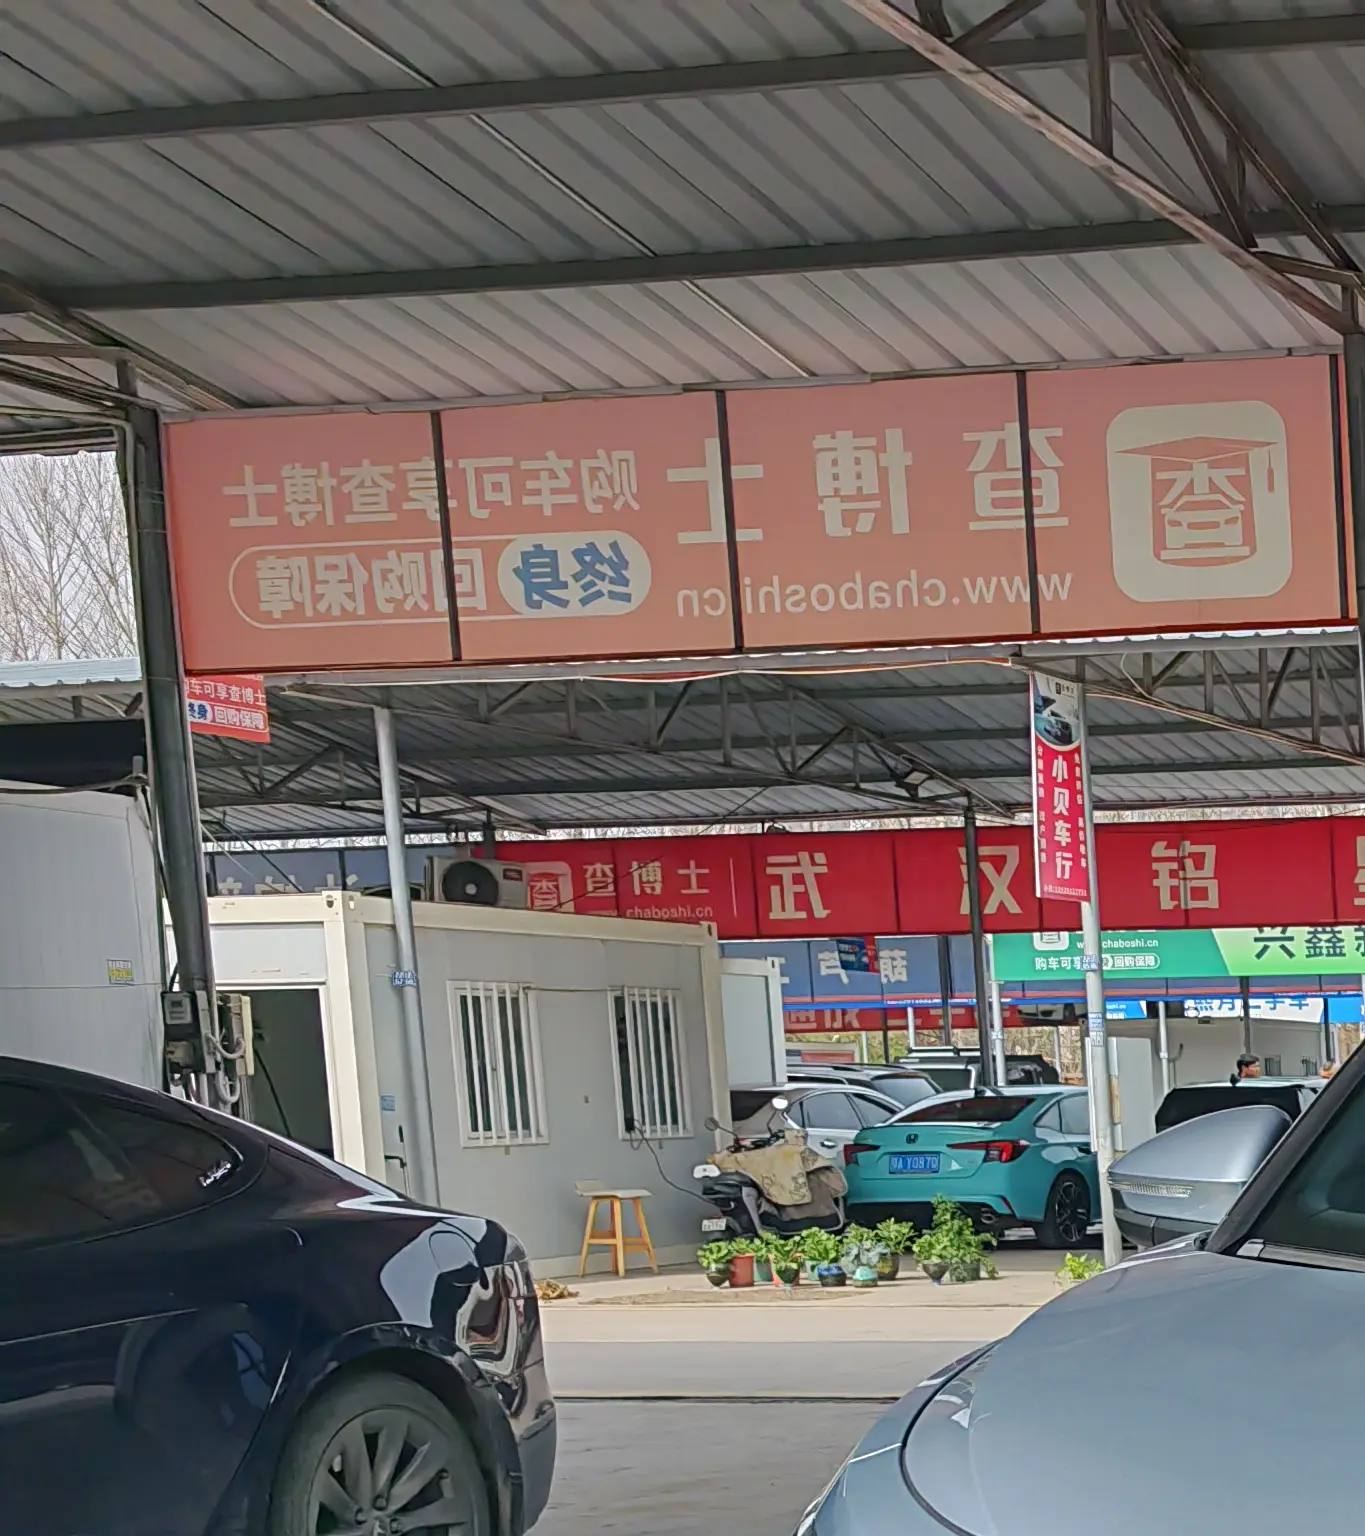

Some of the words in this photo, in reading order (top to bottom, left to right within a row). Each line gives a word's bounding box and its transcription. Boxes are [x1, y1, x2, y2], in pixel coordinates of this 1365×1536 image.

[185, 678, 266, 707] 车可享查博士
[583, 860, 710, 897] 查博士
